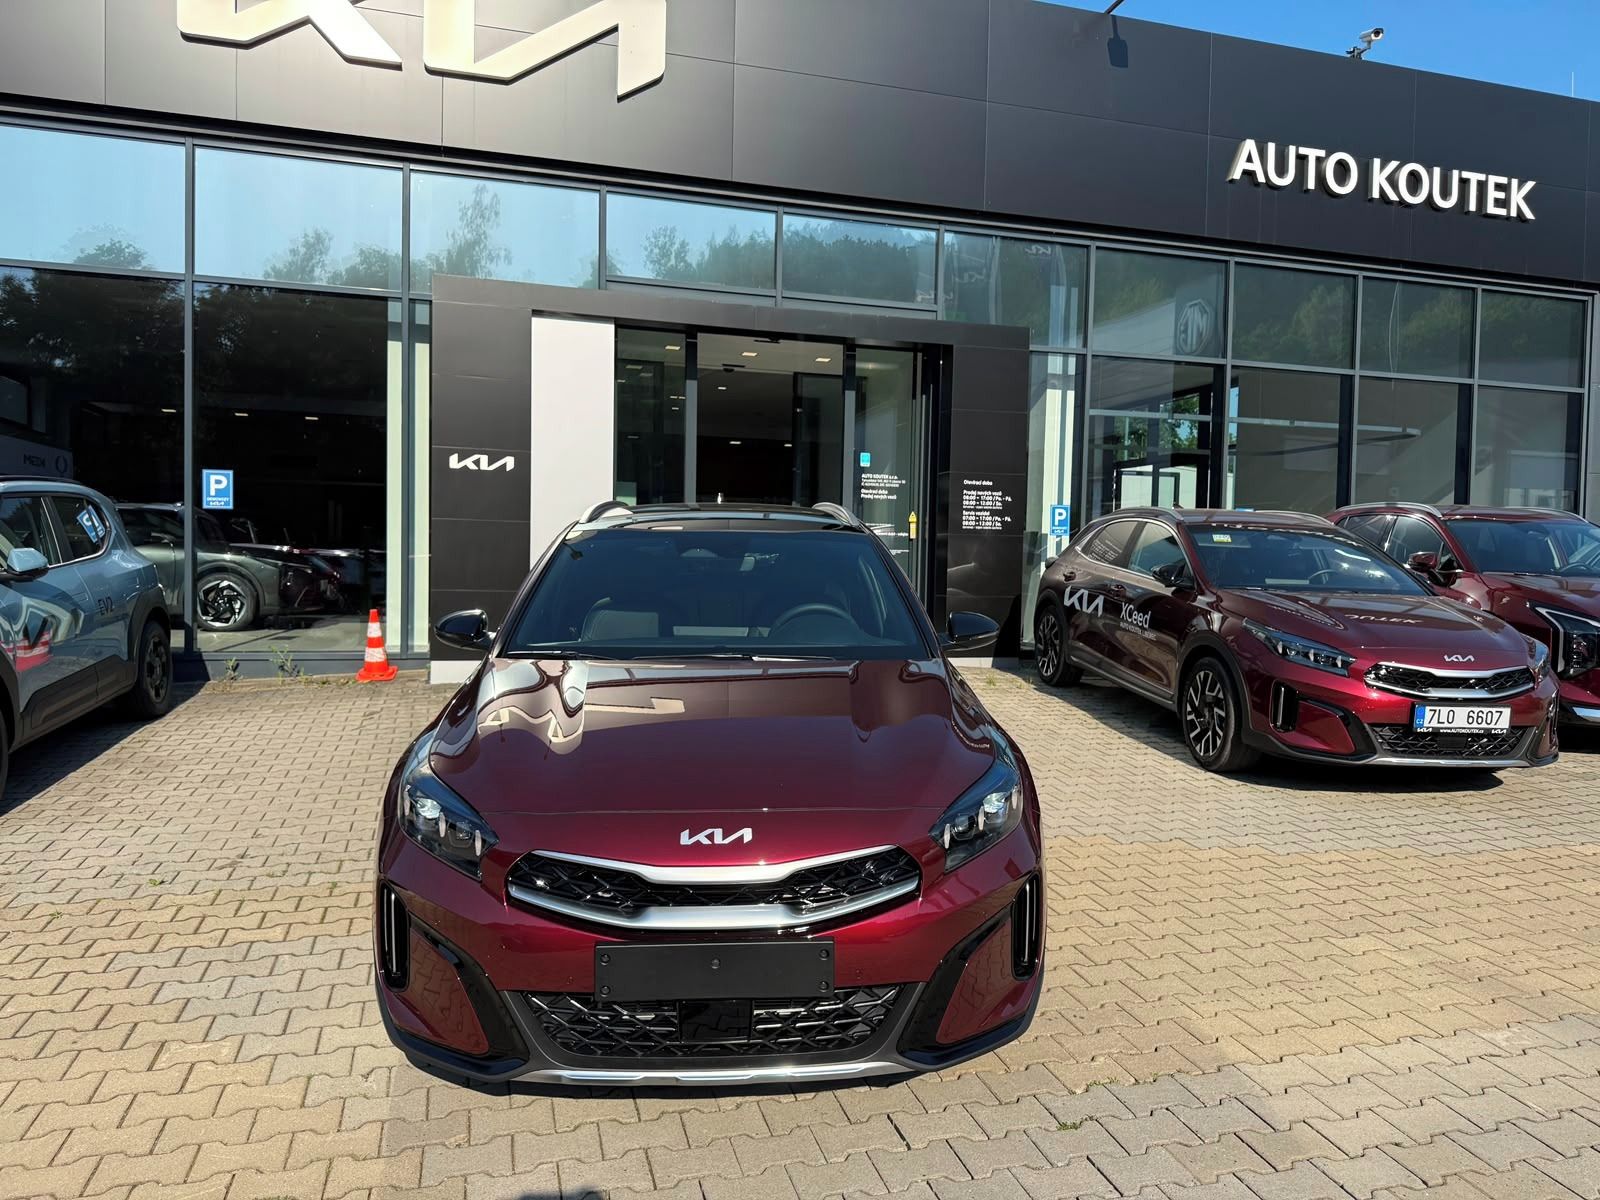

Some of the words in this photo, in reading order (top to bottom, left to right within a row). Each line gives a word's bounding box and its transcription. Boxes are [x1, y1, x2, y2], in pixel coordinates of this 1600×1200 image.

[1228, 138, 1358, 195] AUTO
[1372, 157, 1537, 220] KOUTEK
[449, 453, 514, 472] KIA
[210, 474, 228, 496] P
[1054, 508, 1067, 525] P
[1063, 585, 1104, 617] KIA
[1120, 602, 1151, 629] XCeed
[1444, 654, 1475, 662] KIA
[1467, 709, 1503, 726] 6607
[680, 827, 752, 846] KIA
